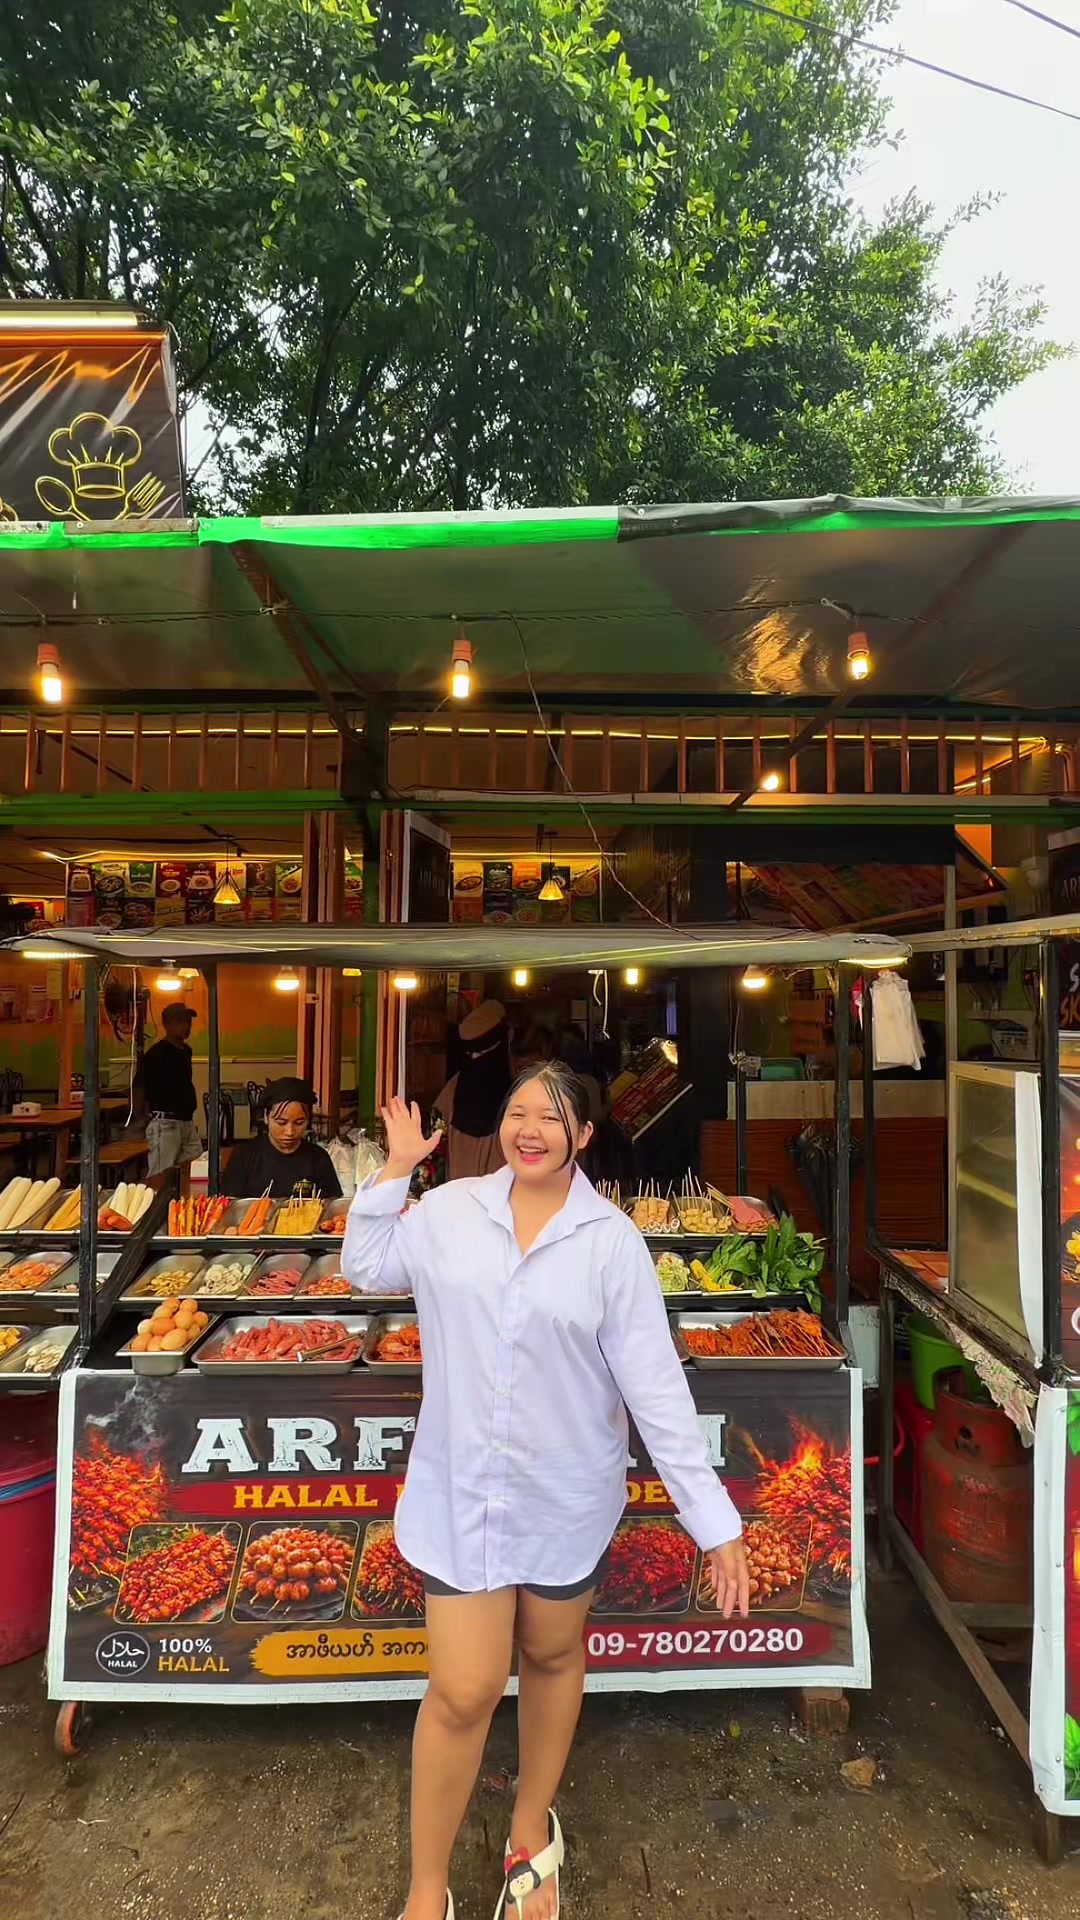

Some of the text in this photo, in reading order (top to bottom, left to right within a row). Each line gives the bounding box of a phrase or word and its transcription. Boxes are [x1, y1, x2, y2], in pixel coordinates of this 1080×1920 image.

[182, 1417, 416, 1472] ARF
[233, 1484, 378, 1509] HALAL
[101, 1638, 145, 1658] حلال
[158, 1637, 213, 1654] 100%
[587, 1628, 804, 1657] 09-780270280
[107, 1660, 138, 1668] HALAL
[157, 1655, 231, 1673] HALAL
